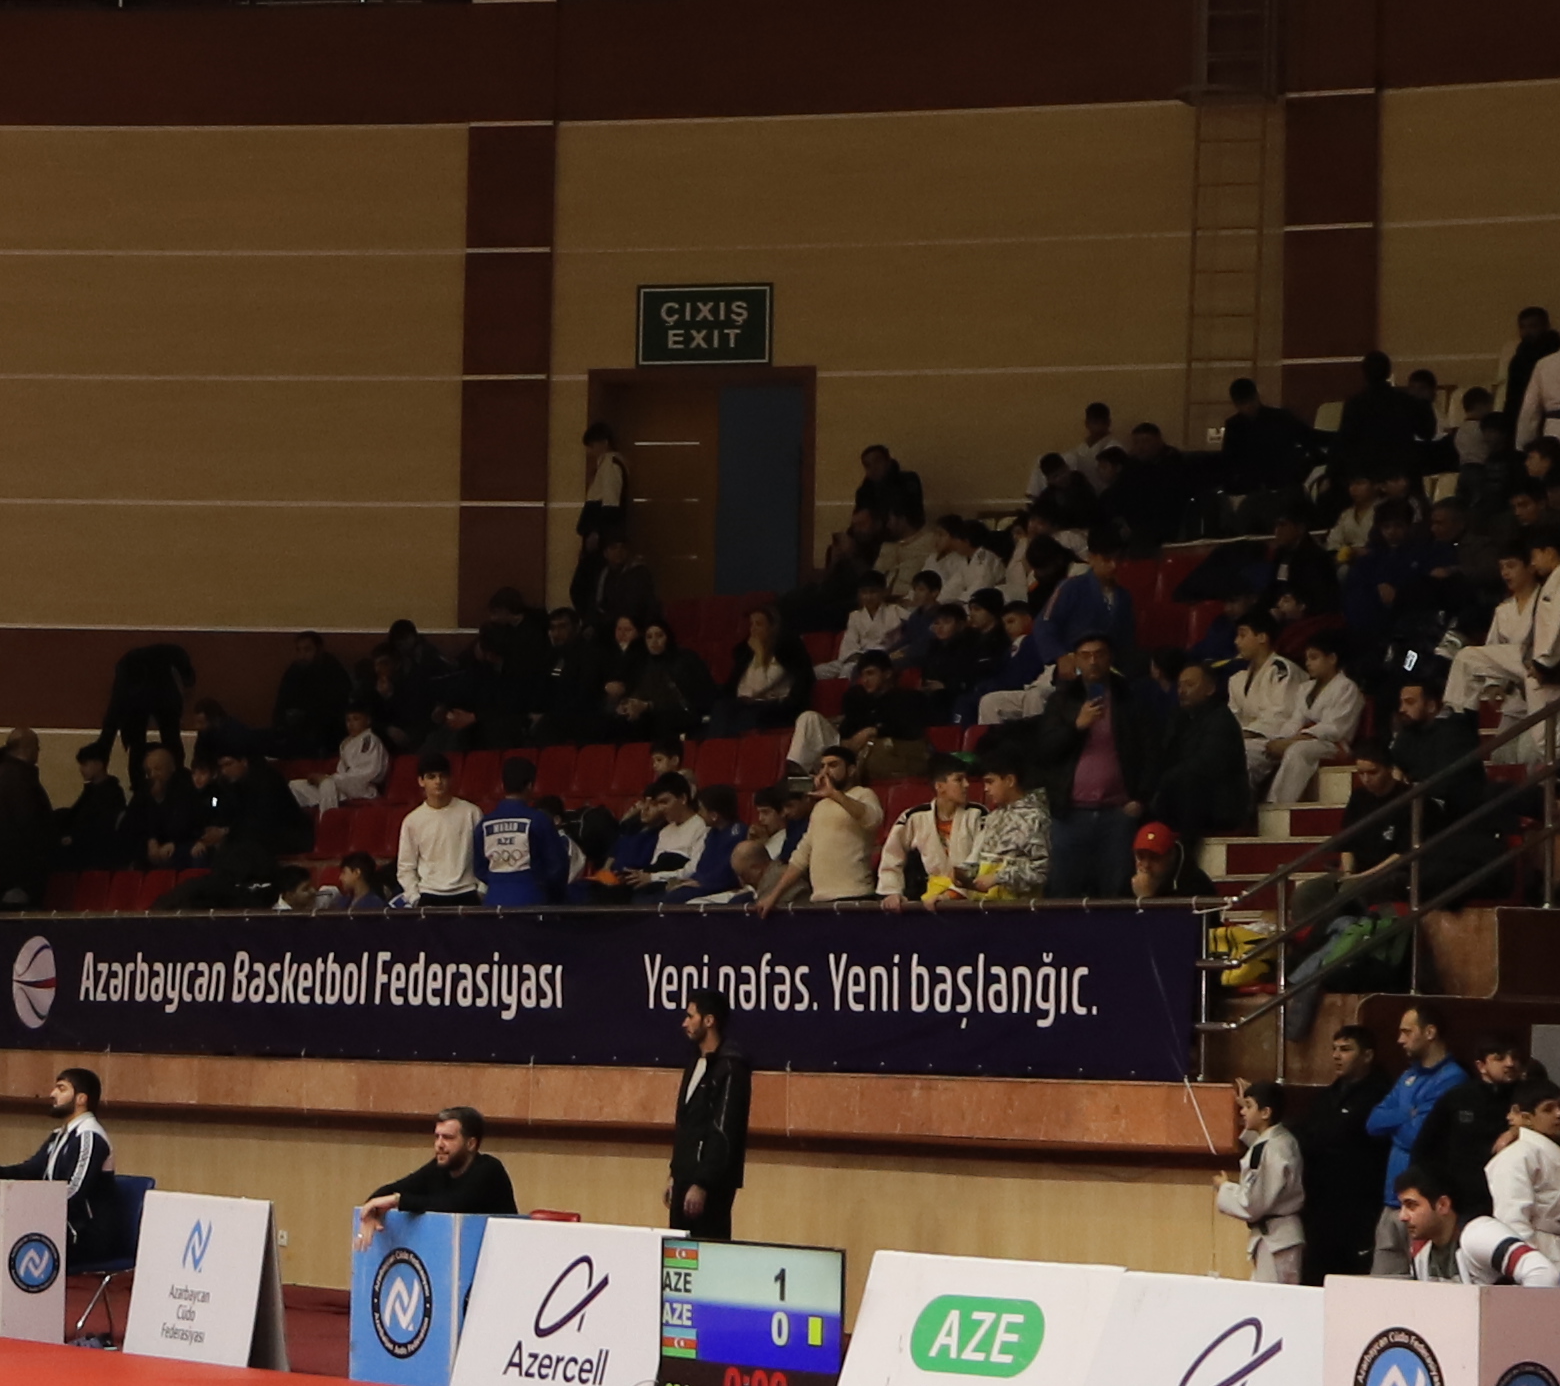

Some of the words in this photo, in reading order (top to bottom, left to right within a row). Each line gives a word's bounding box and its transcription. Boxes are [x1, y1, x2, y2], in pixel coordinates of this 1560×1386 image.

[660, 301, 749, 325] ÇIXIŞ
[667, 329, 741, 349] EXIT
[80, 951, 227, 1013] Azərbaycan
[232, 950, 368, 1005] Basketbol
[375, 951, 564, 1021] Federasiyası
[829, 952, 900, 1012] Yeni
[663, 1270, 692, 1294] AZE
[774, 1267, 787, 1302] 1
[663, 1301, 693, 1326] AZE
[771, 1311, 789, 1347] 0
[927, 1309, 1026, 1365] AZE
[503, 1339, 610, 1386] Azercell
